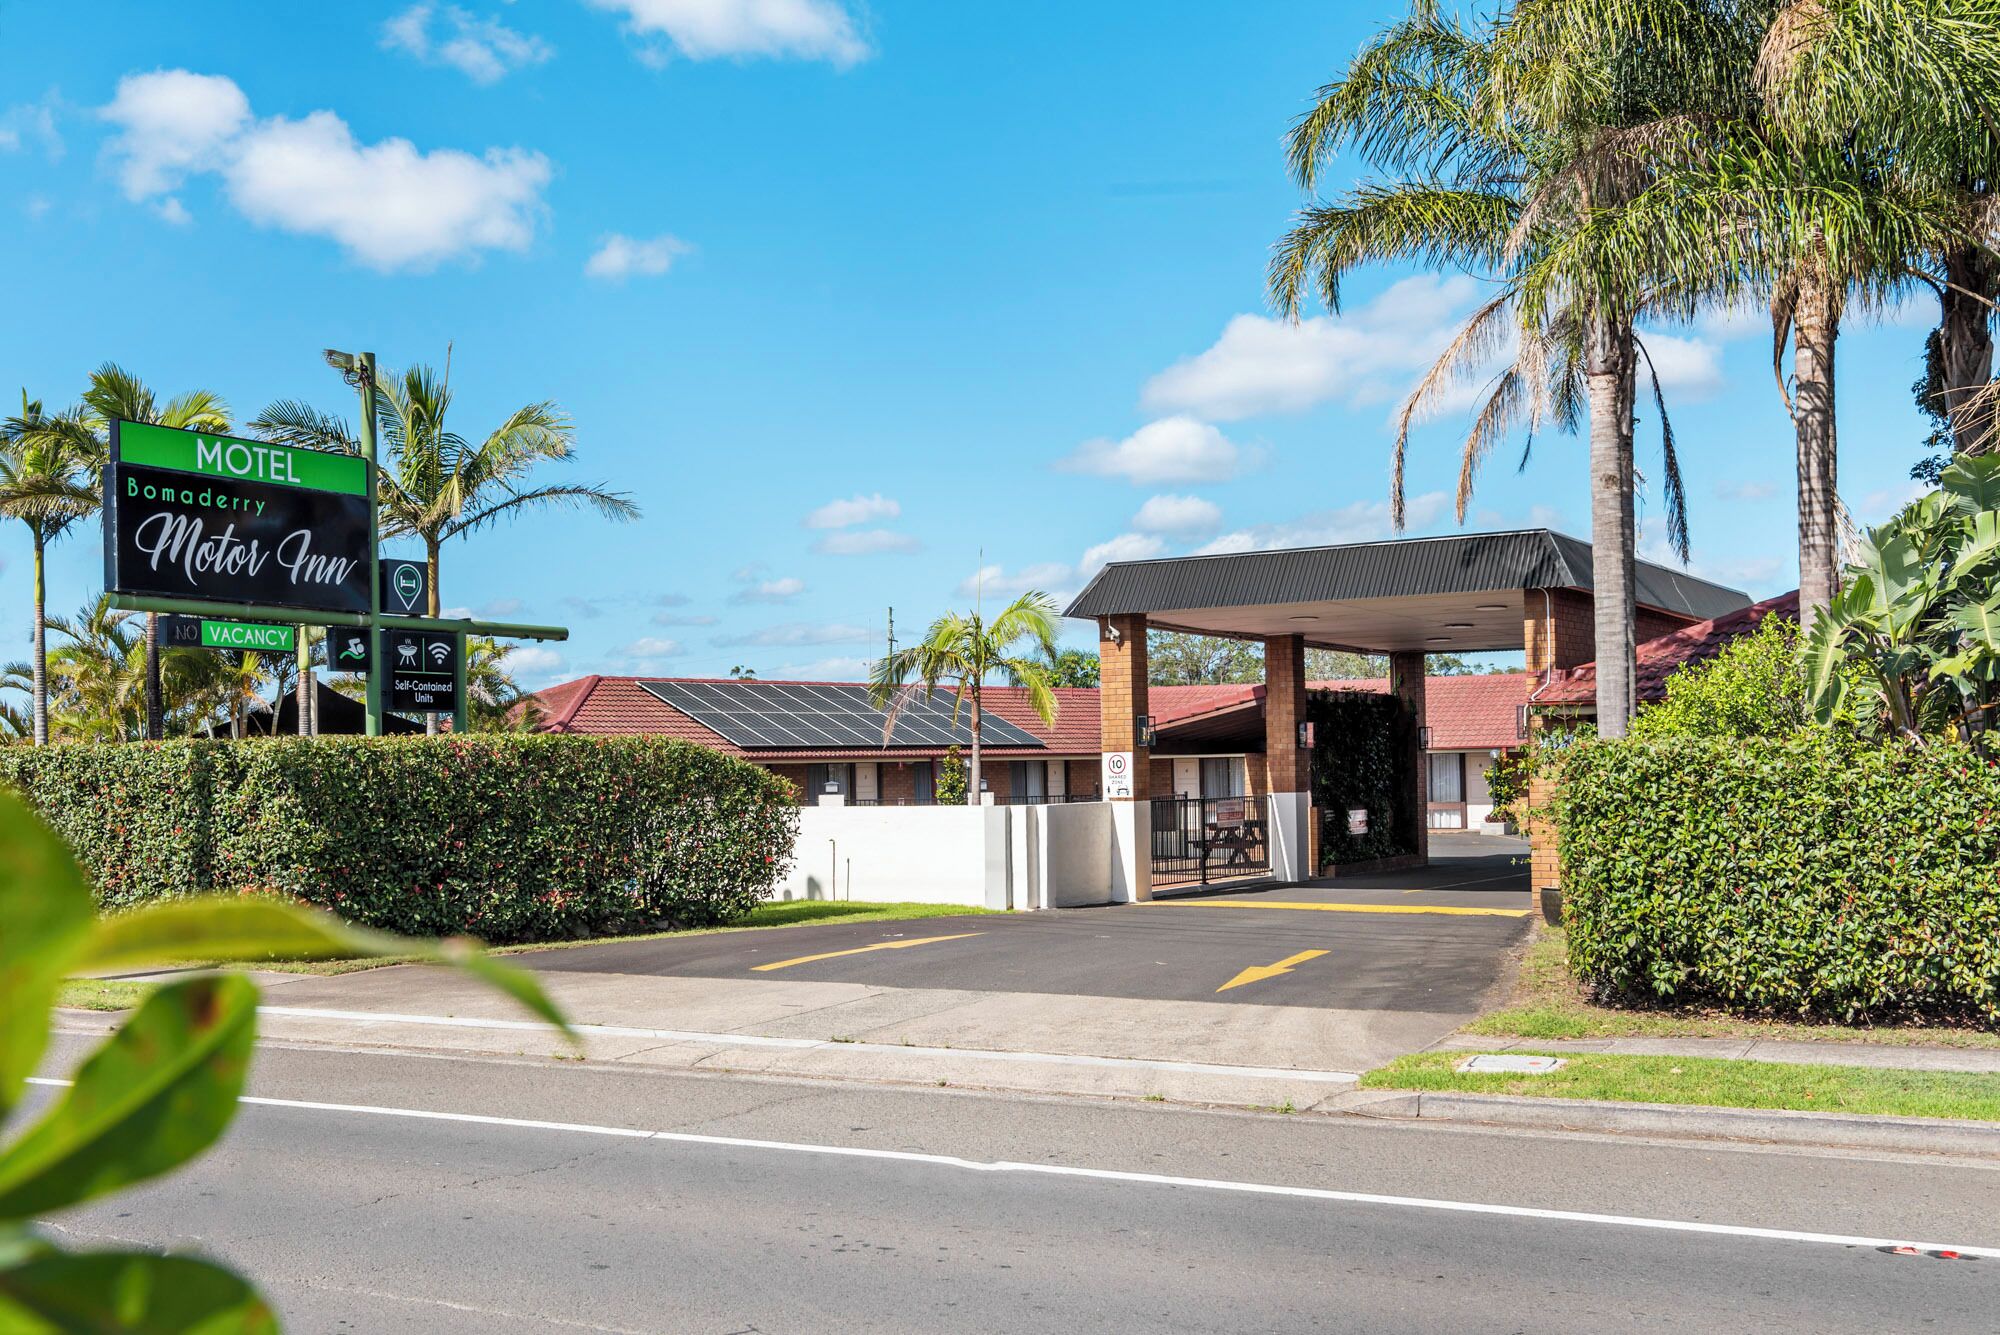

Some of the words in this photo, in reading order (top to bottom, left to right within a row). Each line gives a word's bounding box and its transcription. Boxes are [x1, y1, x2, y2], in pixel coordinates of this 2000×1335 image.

[196, 437, 301, 484] MOTEL
[127, 477, 266, 517] Bomaderry
[134, 512, 270, 587] Motor
[276, 529, 358, 586] Inn
[175, 624, 197, 641] NO
[210, 626, 288, 646] VACANCY
[394, 679, 453, 693] Self-Contained
[414, 691, 434, 704] Units
[1112, 760, 1122, 769] 10
